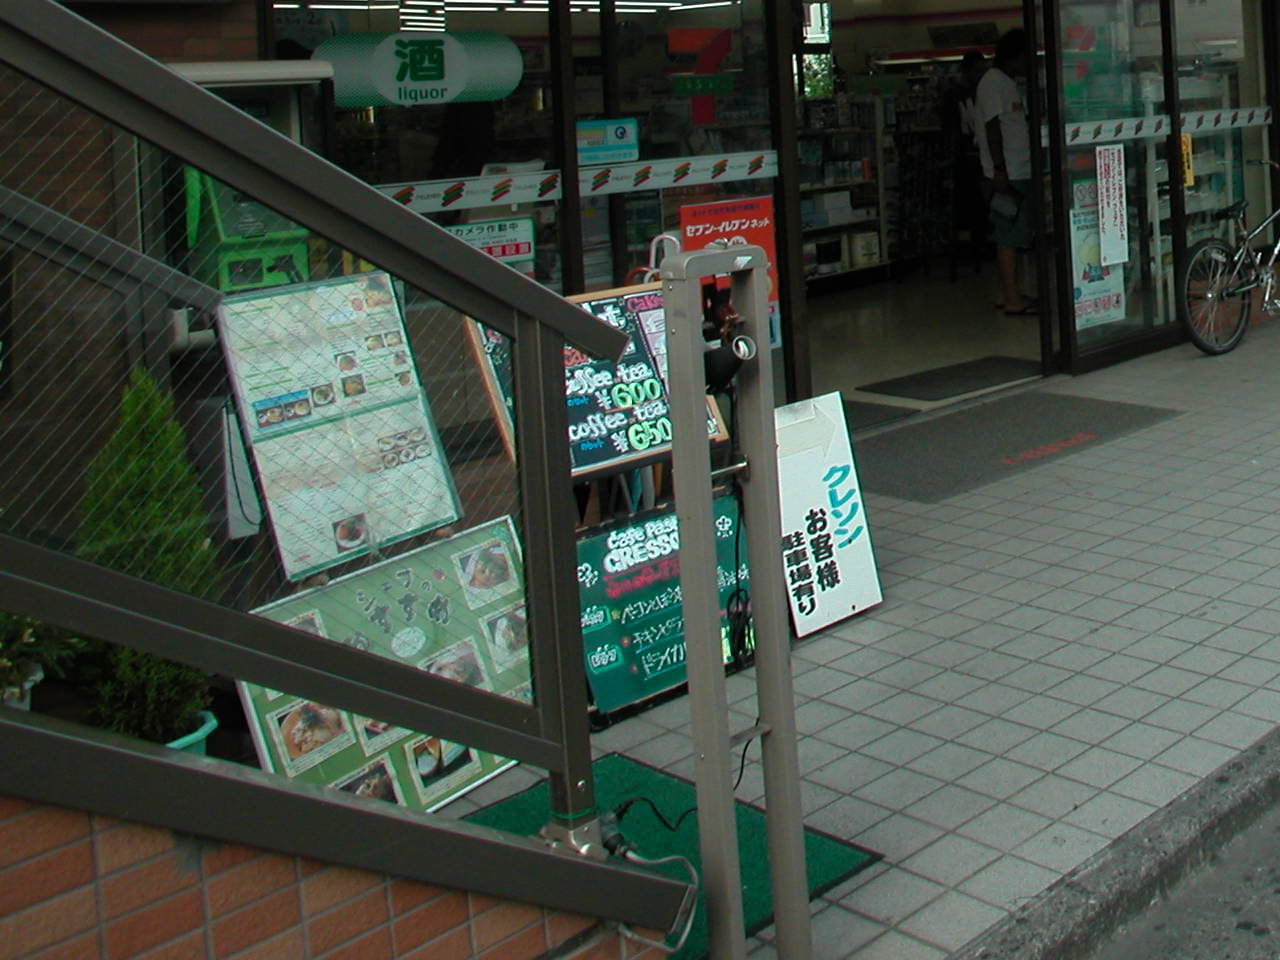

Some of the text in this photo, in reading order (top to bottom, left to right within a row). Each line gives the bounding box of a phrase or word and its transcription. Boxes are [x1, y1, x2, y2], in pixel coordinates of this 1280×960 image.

[394, 39, 445, 82] 酒
[398, 86, 448, 104] liquor
[568, 399, 668, 442] coffee tea
[822, 463, 864, 550] クレソン
[781, 530, 817, 617] 駐車場有り
[804, 507, 841, 593] お客様
